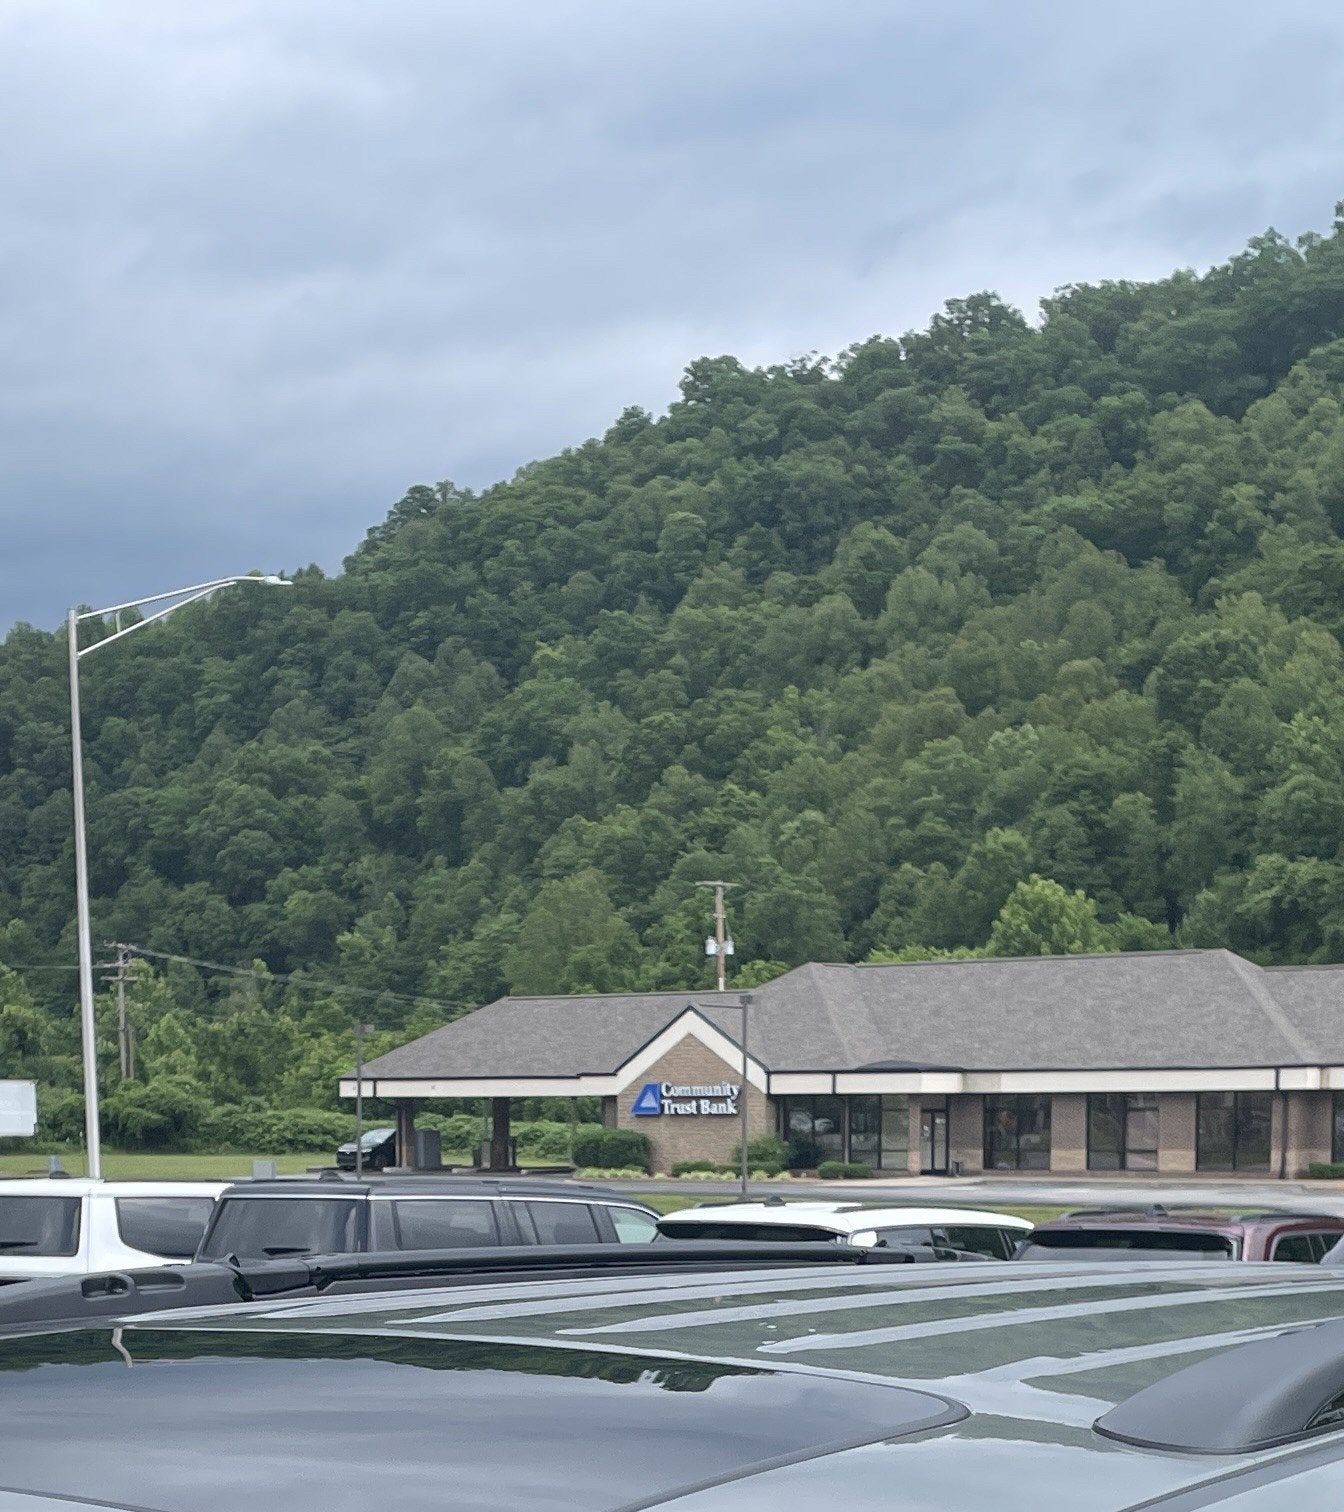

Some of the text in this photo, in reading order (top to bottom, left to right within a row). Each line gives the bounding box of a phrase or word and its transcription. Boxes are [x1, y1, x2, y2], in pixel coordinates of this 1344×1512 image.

[661, 1080, 740, 1100] Community
[661, 1098, 738, 1115] Trust Bank
